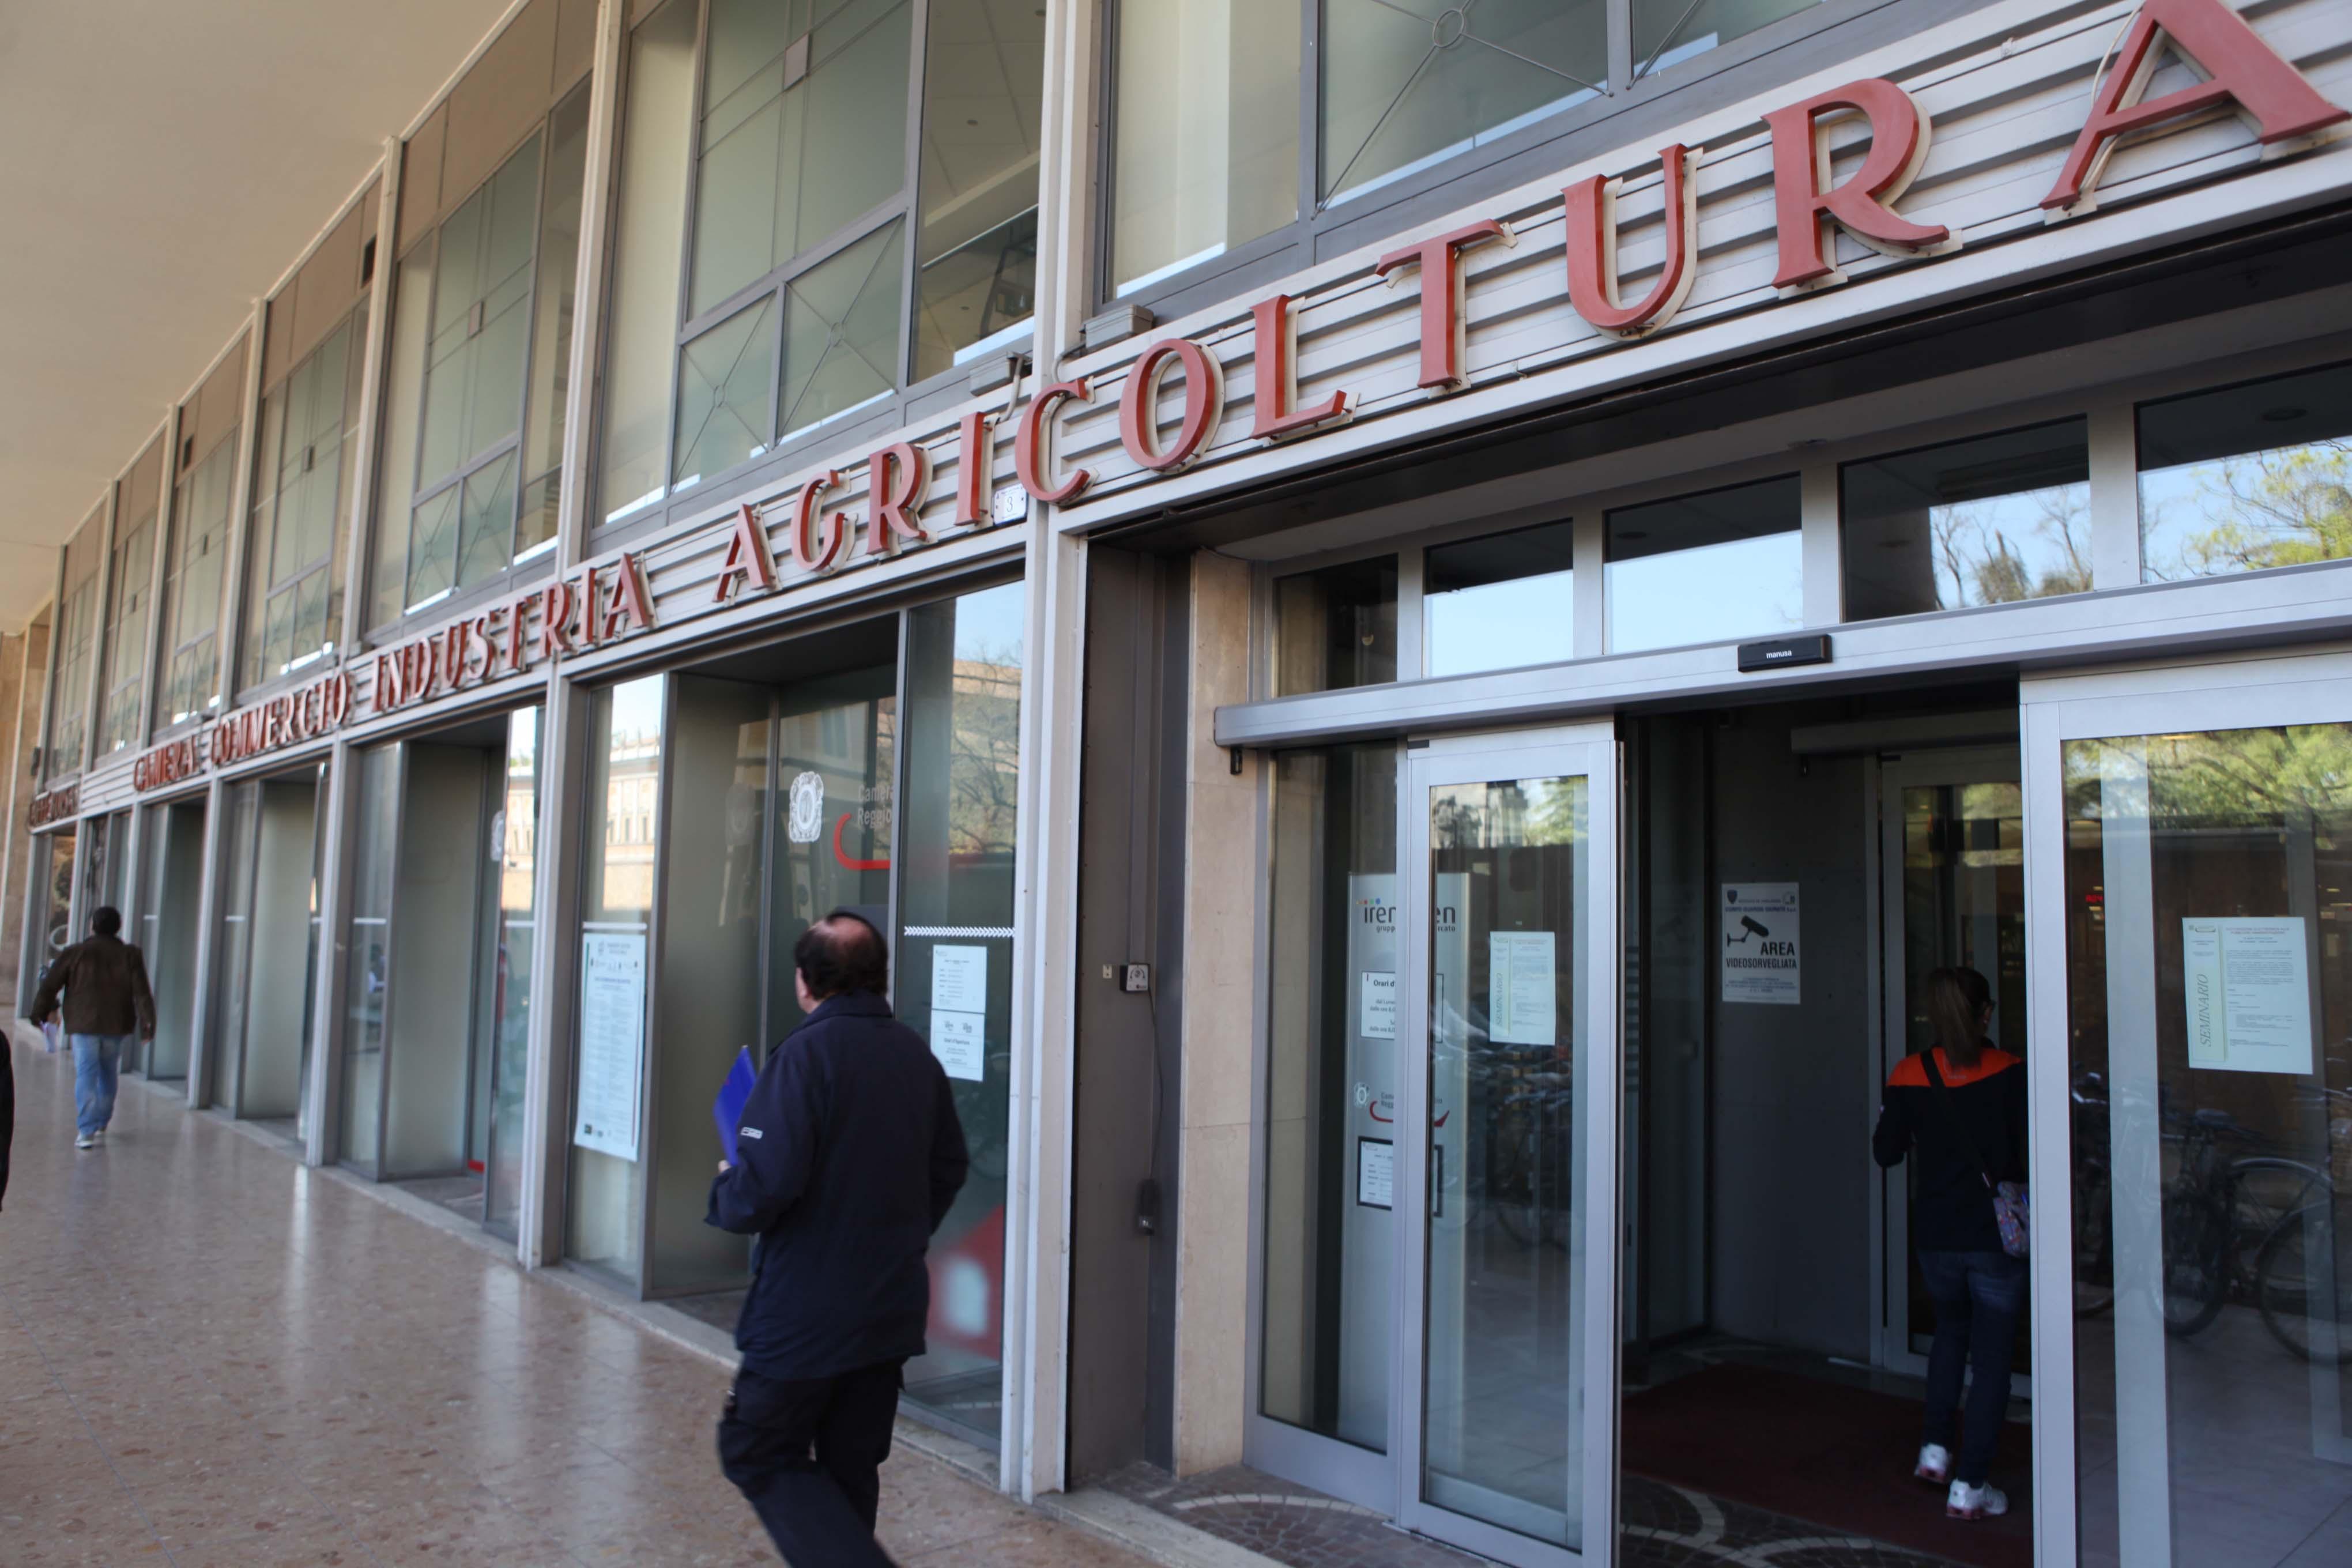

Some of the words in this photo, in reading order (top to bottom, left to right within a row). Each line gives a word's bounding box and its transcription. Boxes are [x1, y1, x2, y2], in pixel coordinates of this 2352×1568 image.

[134, 734, 200, 792] CAMERA
[210, 672, 354, 766] COMMERCIO
[371, 552, 657, 713] INDUSTRIA
[713, 0, 2352, 603] AGRICOLTURA
[1007, 496, 1013, 512] 3
[1766, 650, 1792, 659] manusa
[858, 808, 892, 829] Reggio
[1760, 941, 1796, 956] AREA
[1726, 958, 1797, 970] VIDEOSORVEGLIATA
[2196, 973, 2211, 1047] SEMINARIO
